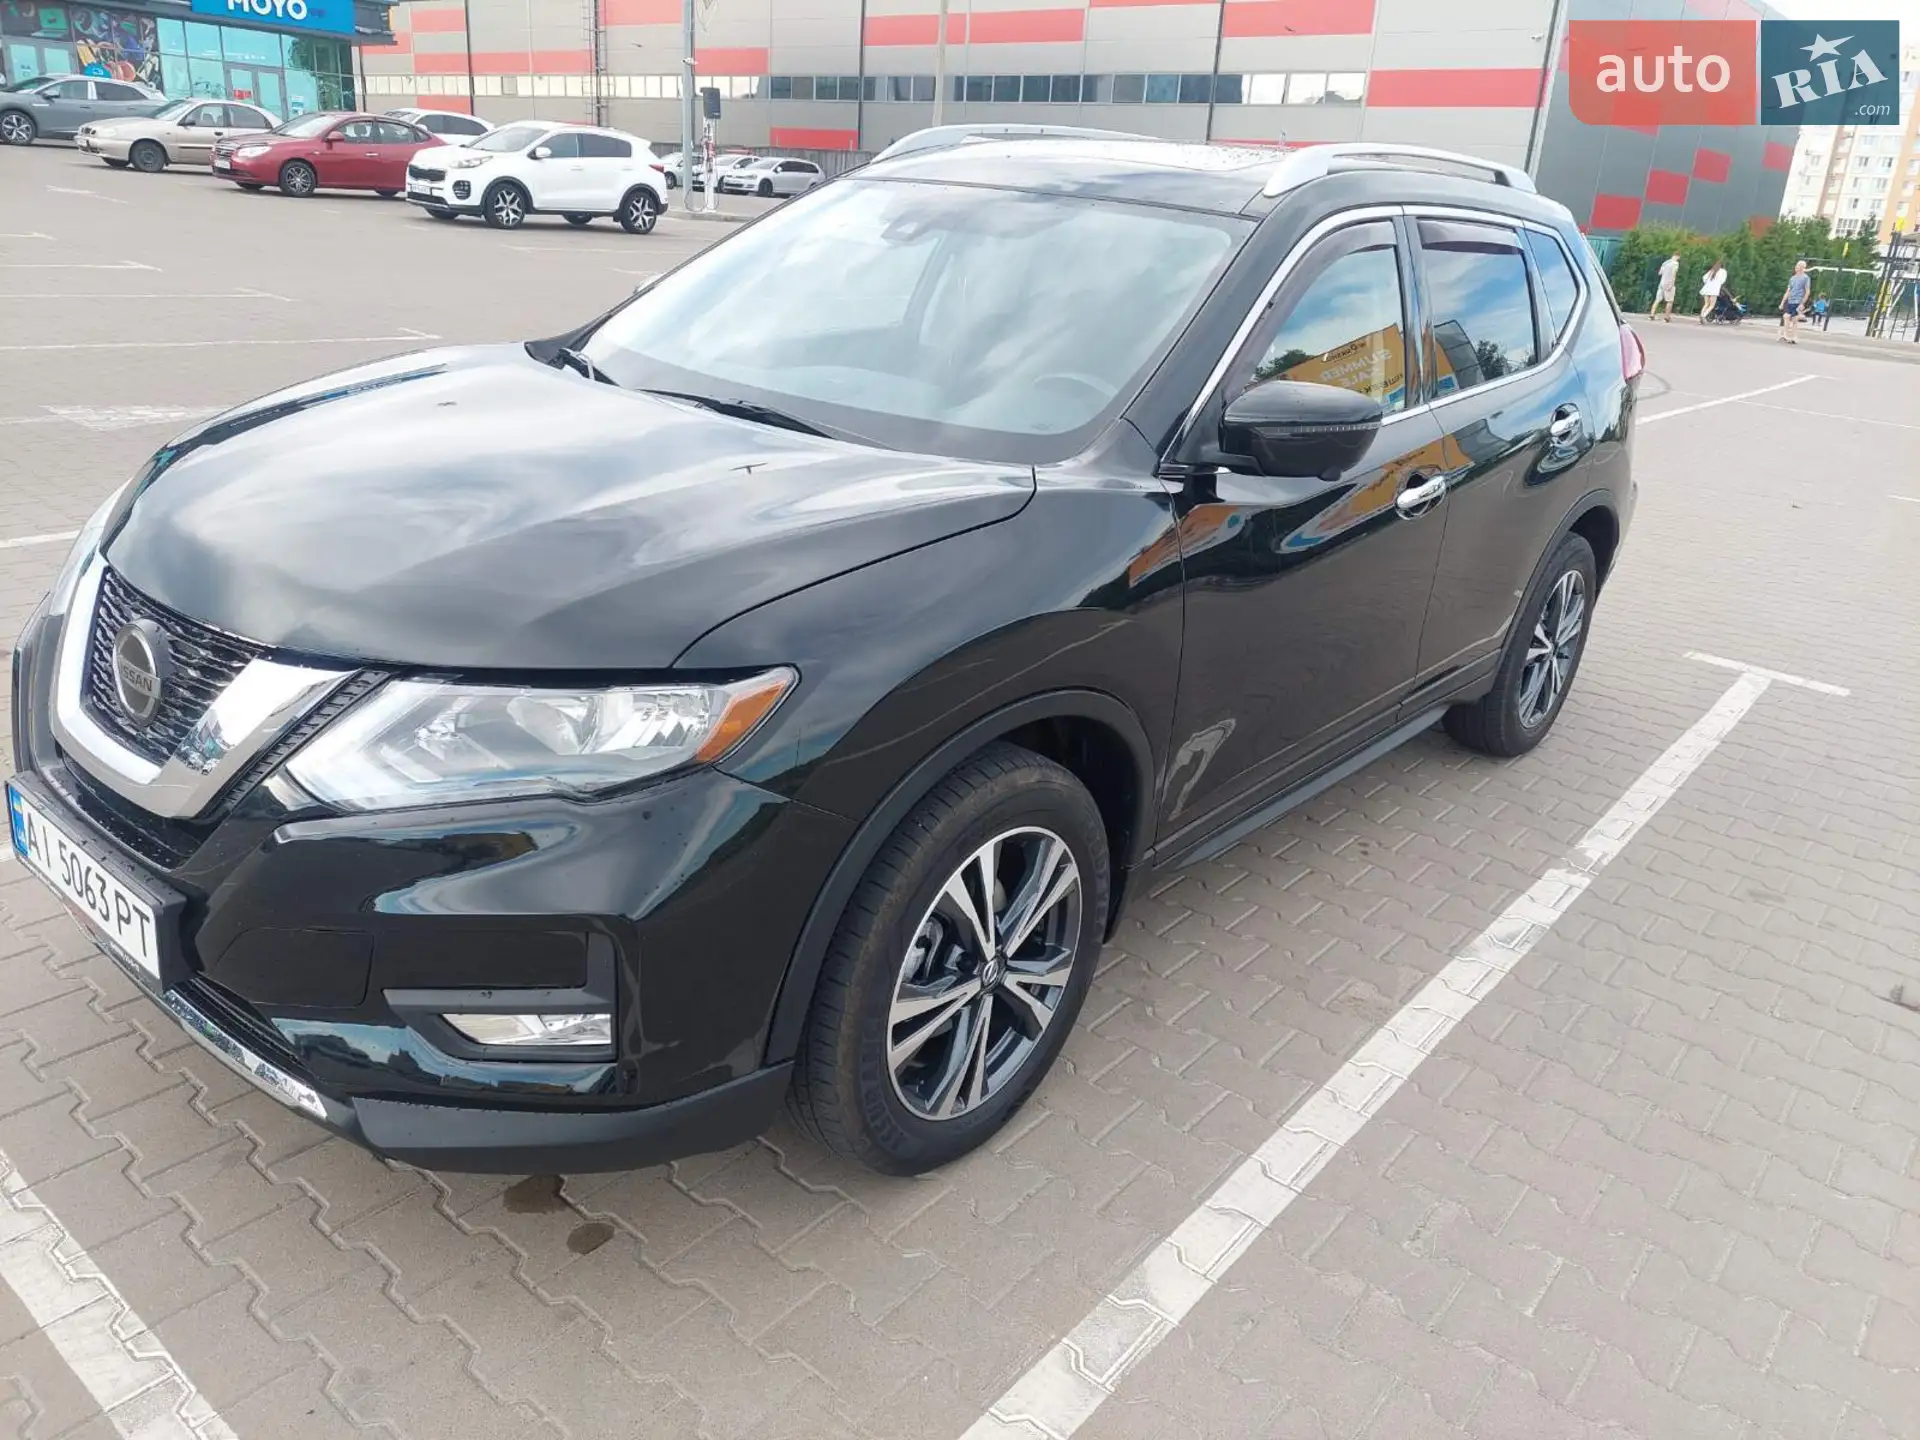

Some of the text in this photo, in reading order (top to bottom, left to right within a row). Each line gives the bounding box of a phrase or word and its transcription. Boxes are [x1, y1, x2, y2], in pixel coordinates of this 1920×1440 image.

[27, 812, 51, 869] AI
[58, 839, 110, 923] 5063
[114, 888, 152, 957] PT
